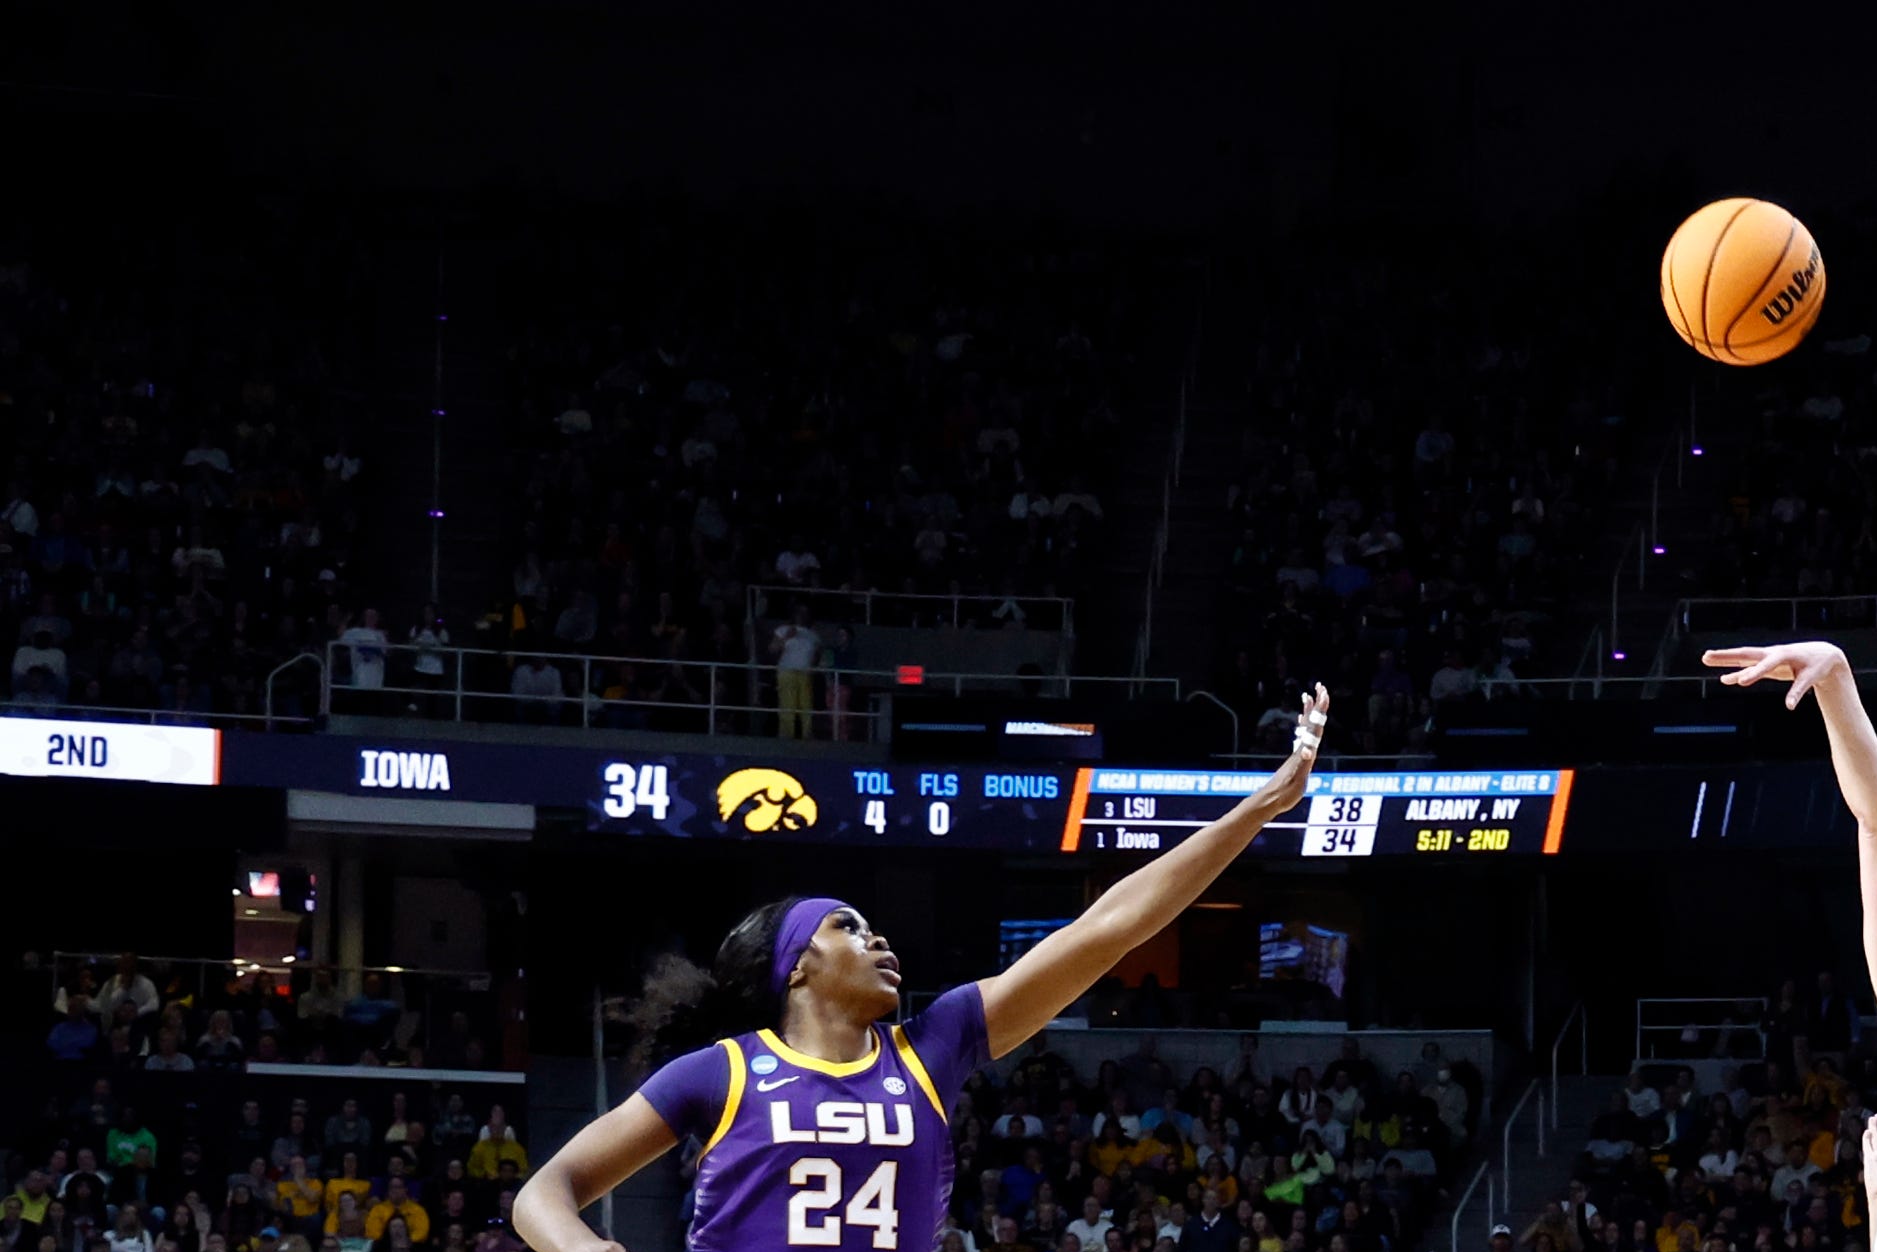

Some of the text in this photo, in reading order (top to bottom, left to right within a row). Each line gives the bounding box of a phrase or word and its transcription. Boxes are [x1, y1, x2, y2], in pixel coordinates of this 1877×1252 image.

[47, 733, 109, 768] 2ND
[359, 749, 451, 791] IOWA
[1096, 774, 1138, 790] NCAA
[1139, 775, 1210, 792] WOMEN'S
[1331, 776, 1401, 793] REGIONAL
[1403, 776, 1415, 793] 2
[1416, 776, 1433, 792] IN
[1435, 775, 1491, 792] ALBANY
[1501, 775, 1537, 791] ELITE
[603, 763, 671, 821] 34
[853, 771, 1059, 799] TOL FLS BONUS
[863, 801, 951, 836] 4 0
[1104, 797, 1157, 819] 3 LSU
[1328, 797, 1364, 823] 38
[1491, 798, 1521, 821] NY
[1096, 828, 1160, 850] 1 Iowa
[1321, 828, 1357, 853] 34
[1416, 829, 1454, 852] 5:11
[1467, 829, 1511, 852] 2ND
[769, 1100, 916, 1148] LSU
[787, 1157, 899, 1251] 24
